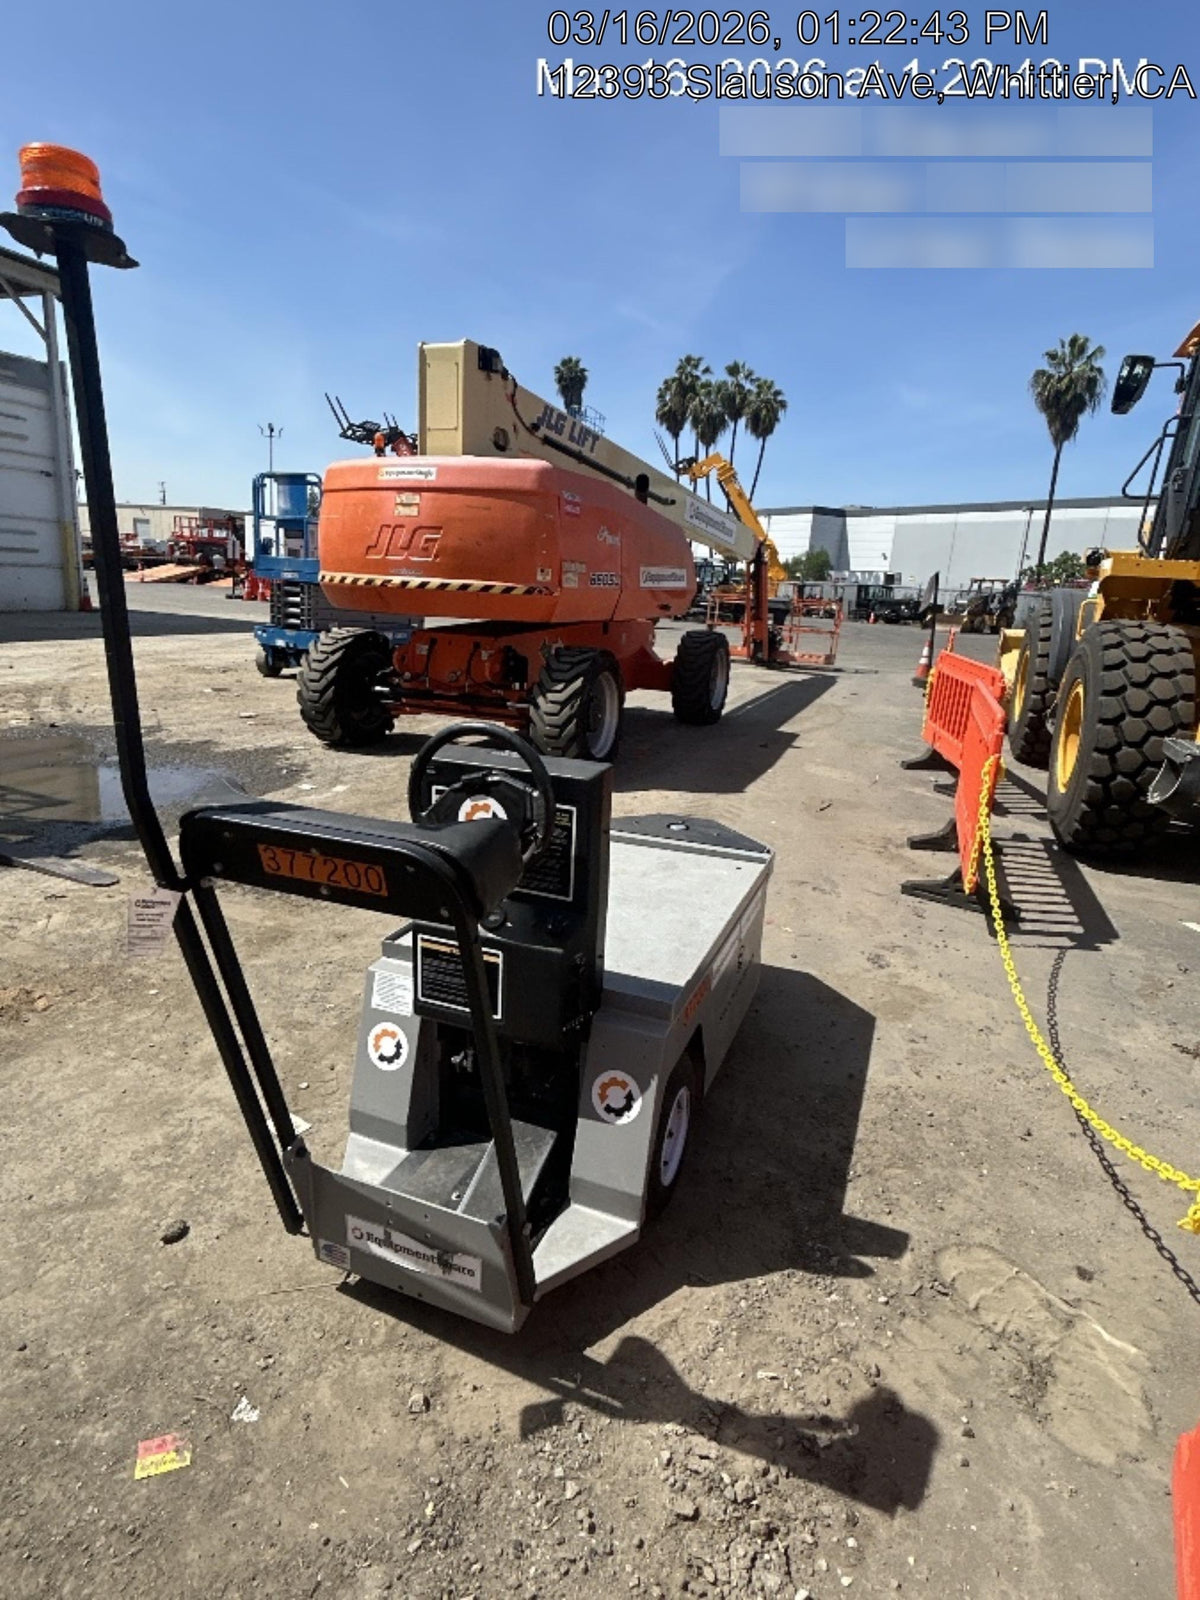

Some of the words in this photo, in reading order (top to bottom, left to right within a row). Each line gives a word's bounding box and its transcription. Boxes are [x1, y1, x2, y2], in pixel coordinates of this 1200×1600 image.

[531, 403, 568, 436] JLG
[569, 420, 600, 453] LIFT
[365, 524, 443, 562] JLG
[263, 845, 382, 893] 377200
